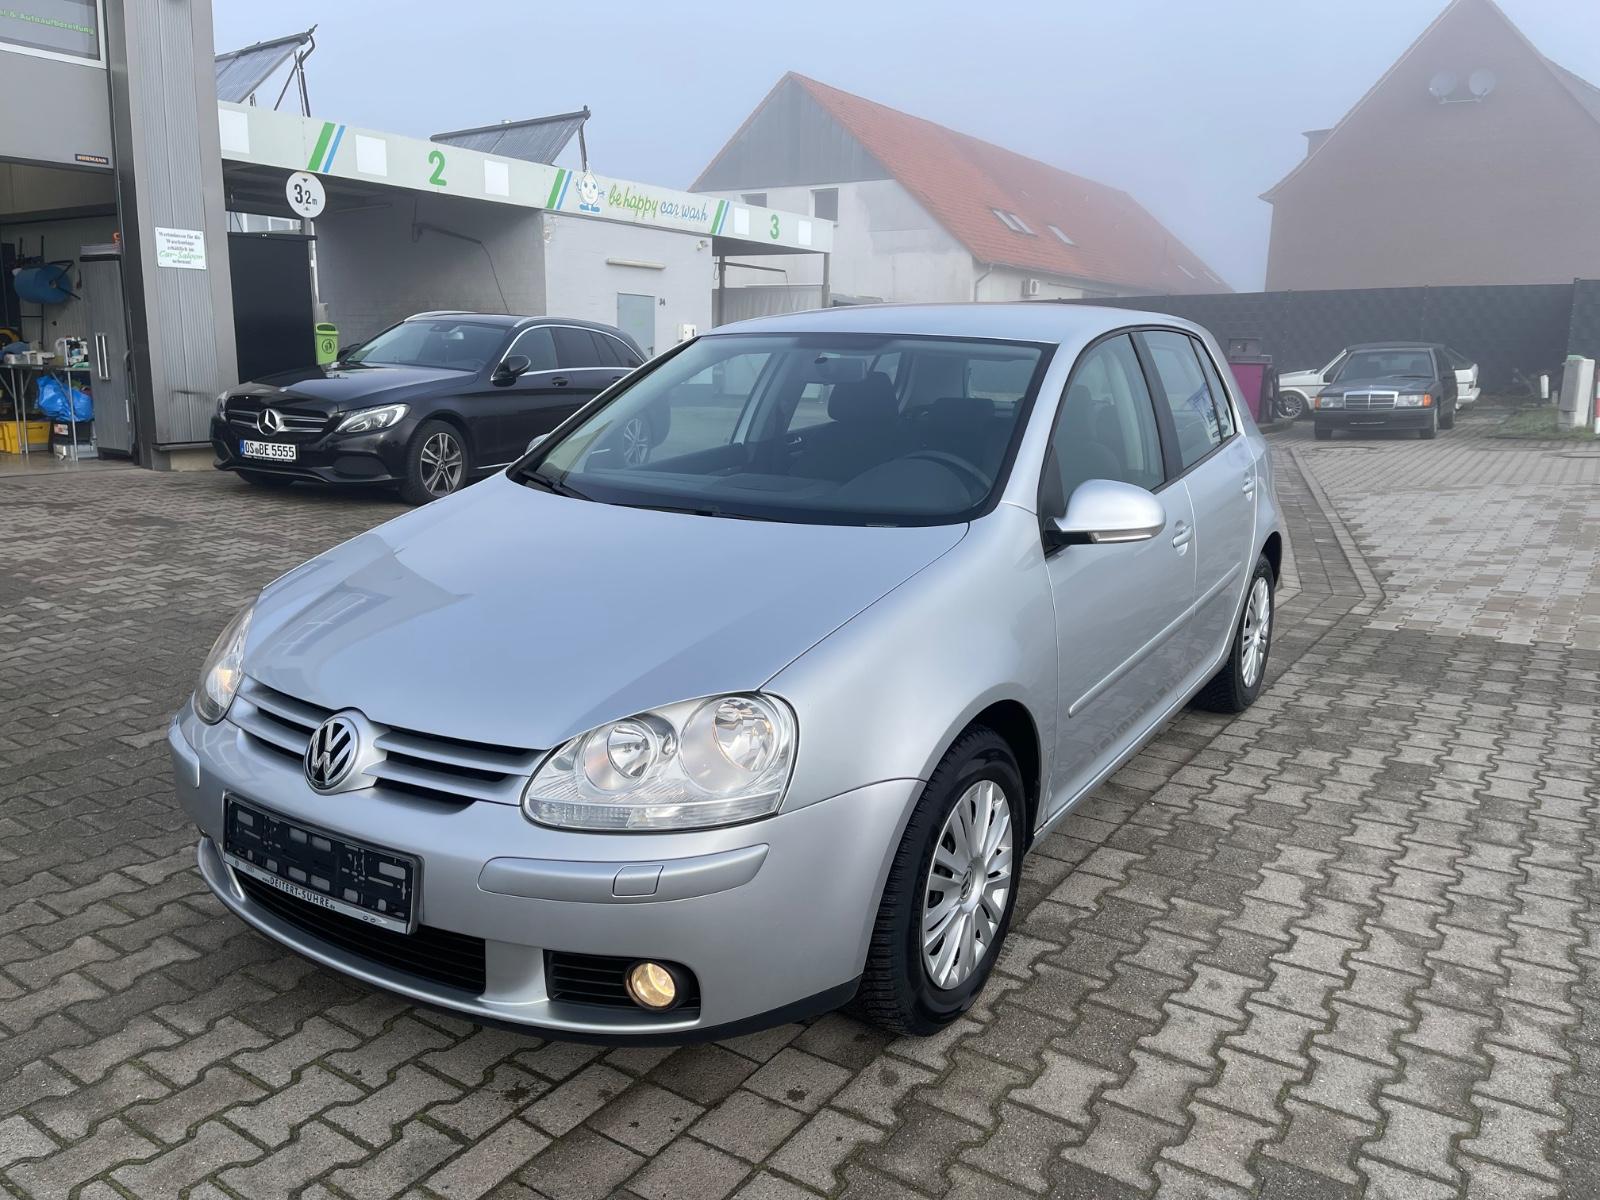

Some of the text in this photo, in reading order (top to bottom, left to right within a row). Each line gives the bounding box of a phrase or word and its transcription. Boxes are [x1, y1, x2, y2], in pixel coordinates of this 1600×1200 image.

[428, 150, 447, 187] 2
[608, 183, 709, 222] be happy car wash
[769, 214, 780, 240] 3
[244, 441, 255, 454] OS
[259, 443, 271, 456] BE
[271, 445, 295, 458] 5555
